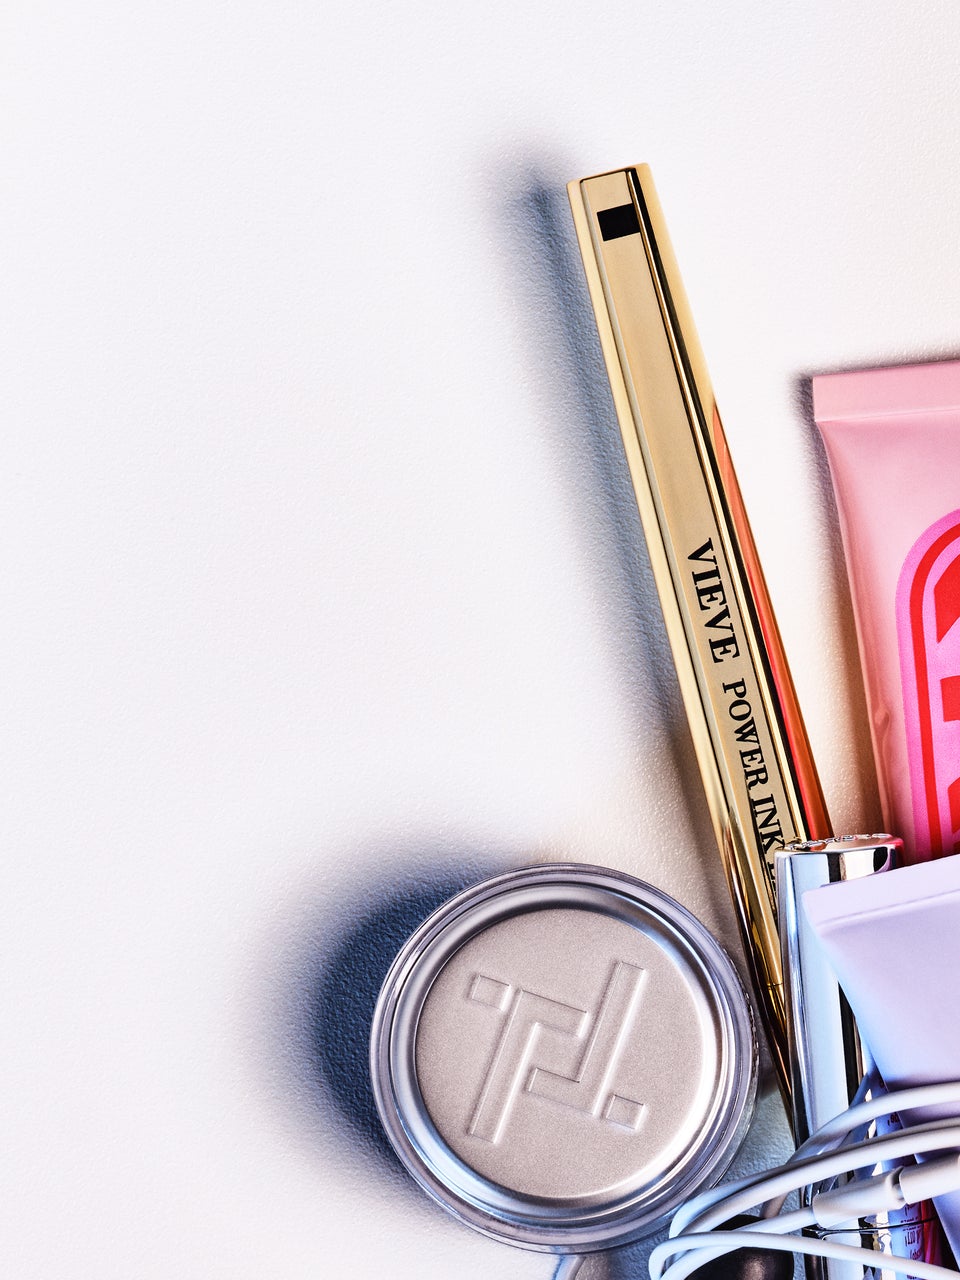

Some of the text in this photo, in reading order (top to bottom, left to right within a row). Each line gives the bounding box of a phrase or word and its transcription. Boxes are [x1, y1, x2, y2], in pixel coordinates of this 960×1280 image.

[688, 538, 786, 854] VIEVE POWER INK
